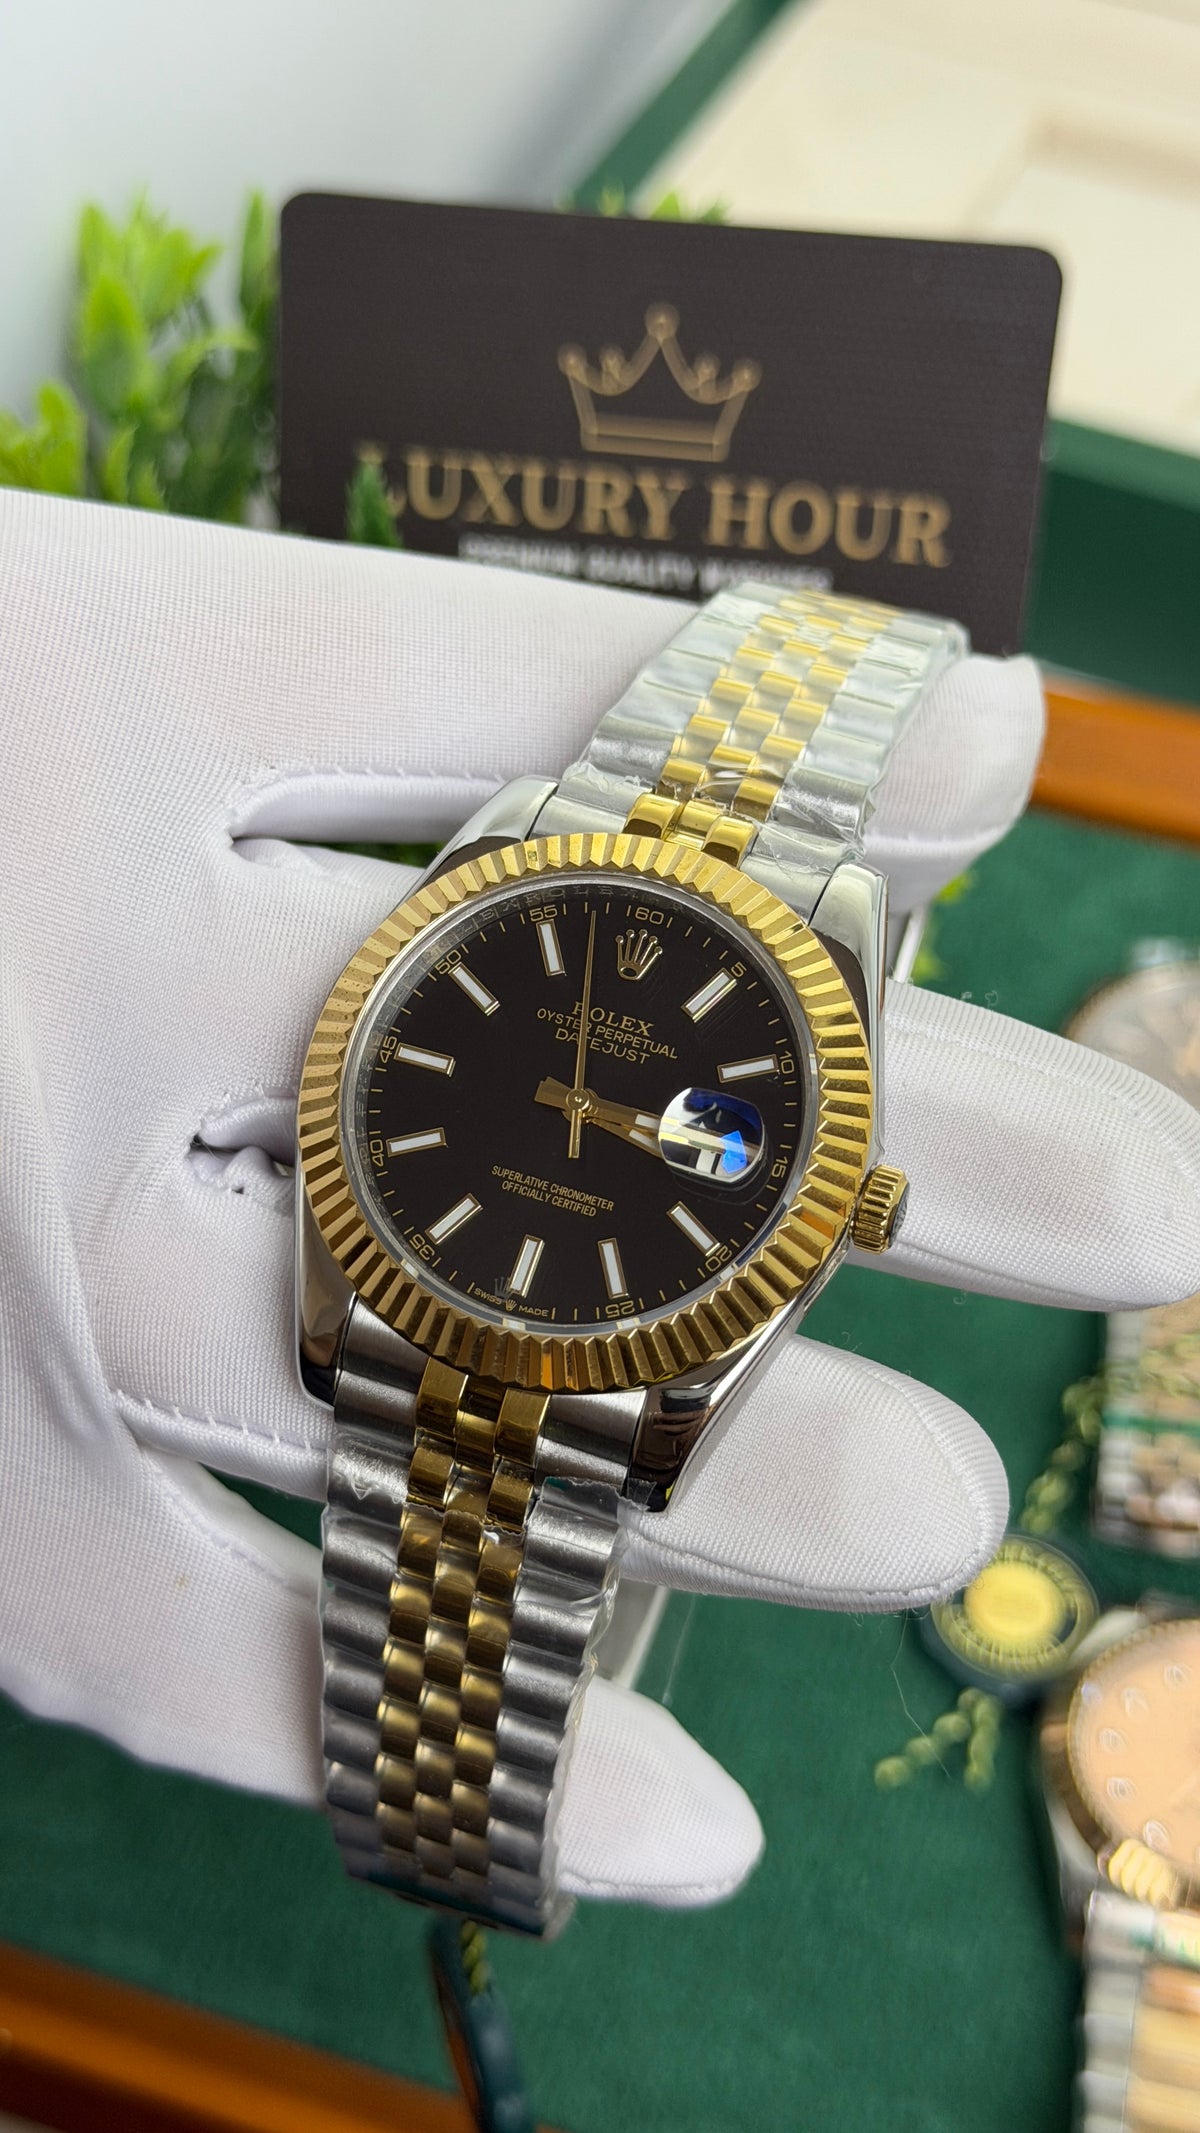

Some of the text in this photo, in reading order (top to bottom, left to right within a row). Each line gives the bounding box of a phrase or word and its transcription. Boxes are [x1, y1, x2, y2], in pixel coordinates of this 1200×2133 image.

[705, 475, 950, 568] HOUR
[529, 904, 558, 923] 55
[634, 906, 665, 924] 60
[435, 949, 462, 976] 50
[731, 961, 747, 978] 5
[379, 1035, 397, 1064] 45
[595, 1025, 678, 1060] PERPETUAL
[779, 1050, 795, 1075] 10
[370, 1138, 384, 1168] 40
[771, 1156, 789, 1179] 15
[491, 1165, 615, 1211] SUPERLATIVE CHRONOMETER
[501, 1180, 597, 1217] OFFICIALLY CERTIFIED
[409, 1233, 435, 1261] 35
[705, 1245, 733, 1272] 20
[474, 1287, 549, 1317] SWISS MADE
[605, 1300, 636, 1319] 25
